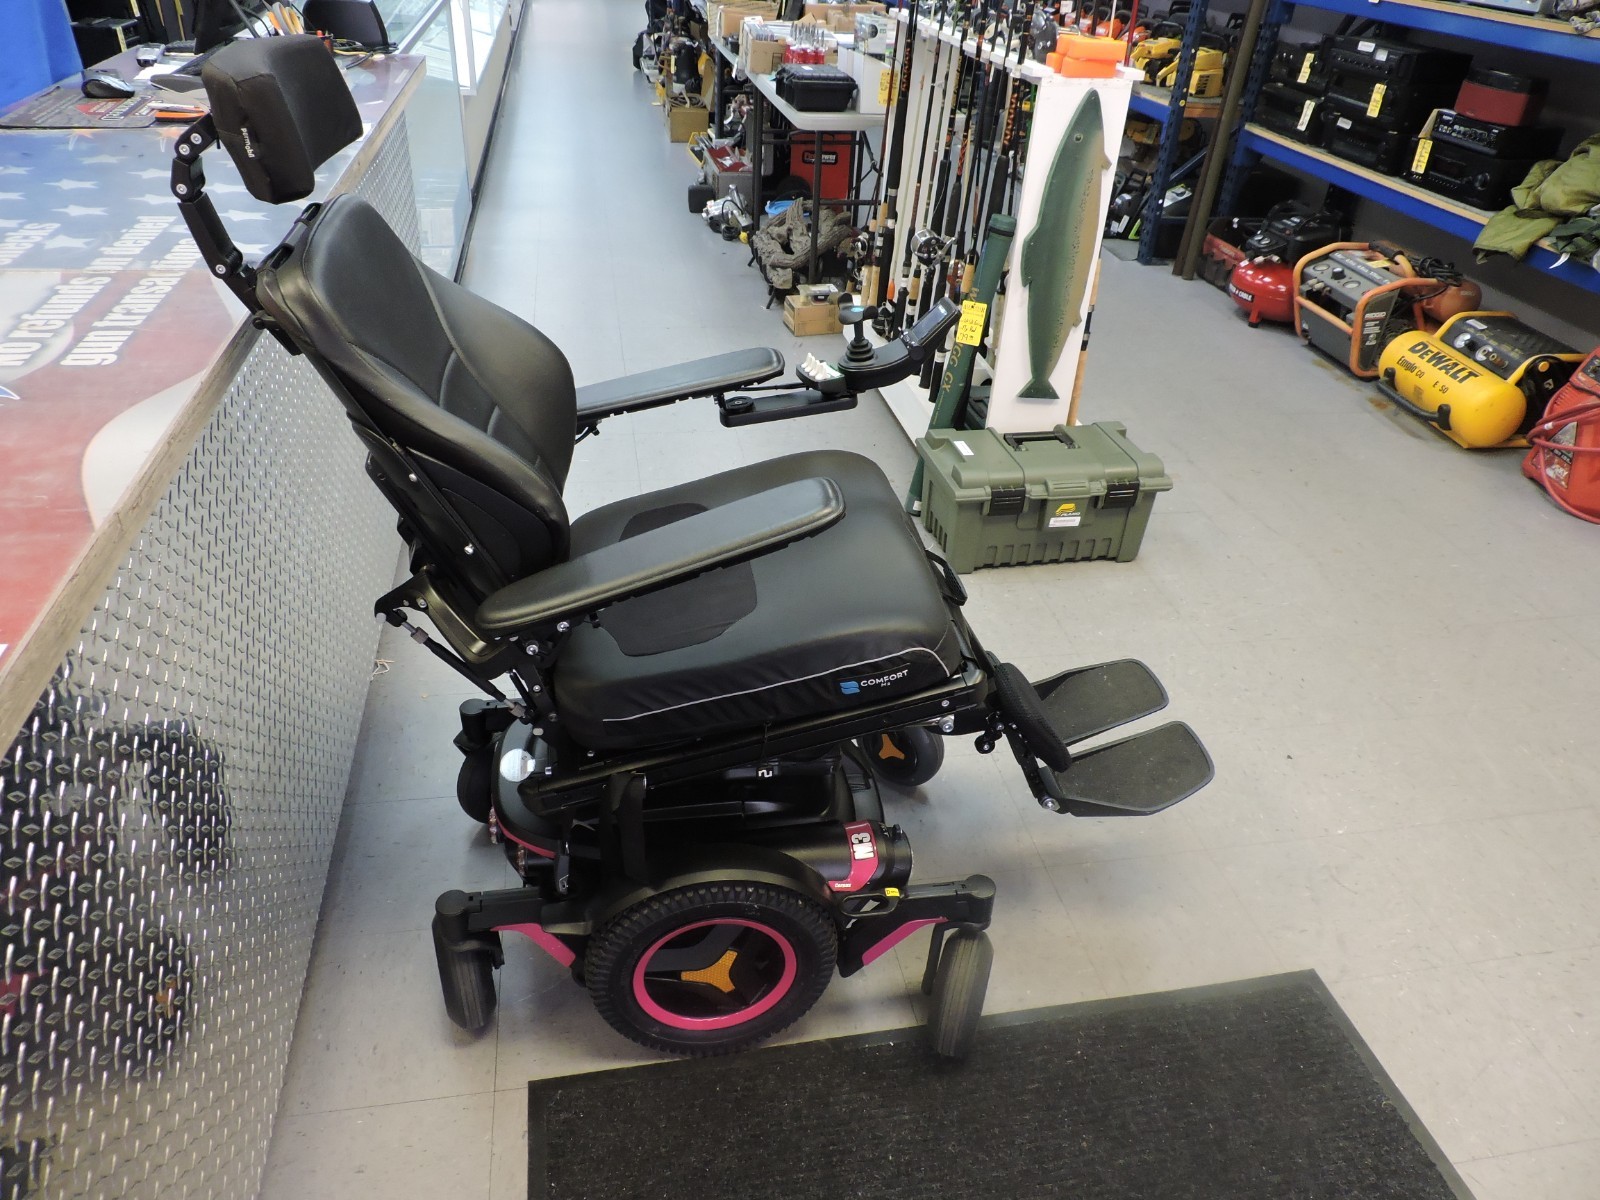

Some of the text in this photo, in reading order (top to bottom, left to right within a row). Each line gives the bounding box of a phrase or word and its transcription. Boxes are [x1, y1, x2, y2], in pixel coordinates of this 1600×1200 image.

[240, 127, 255, 158] permobil
[99, 215, 177, 254] denied
[82, 257, 134, 274] on
[8, 276, 112, 338] refunds
[60, 330, 134, 366] gun
[860, 669, 909, 687] COMFORT
[851, 832, 875, 860] M3
